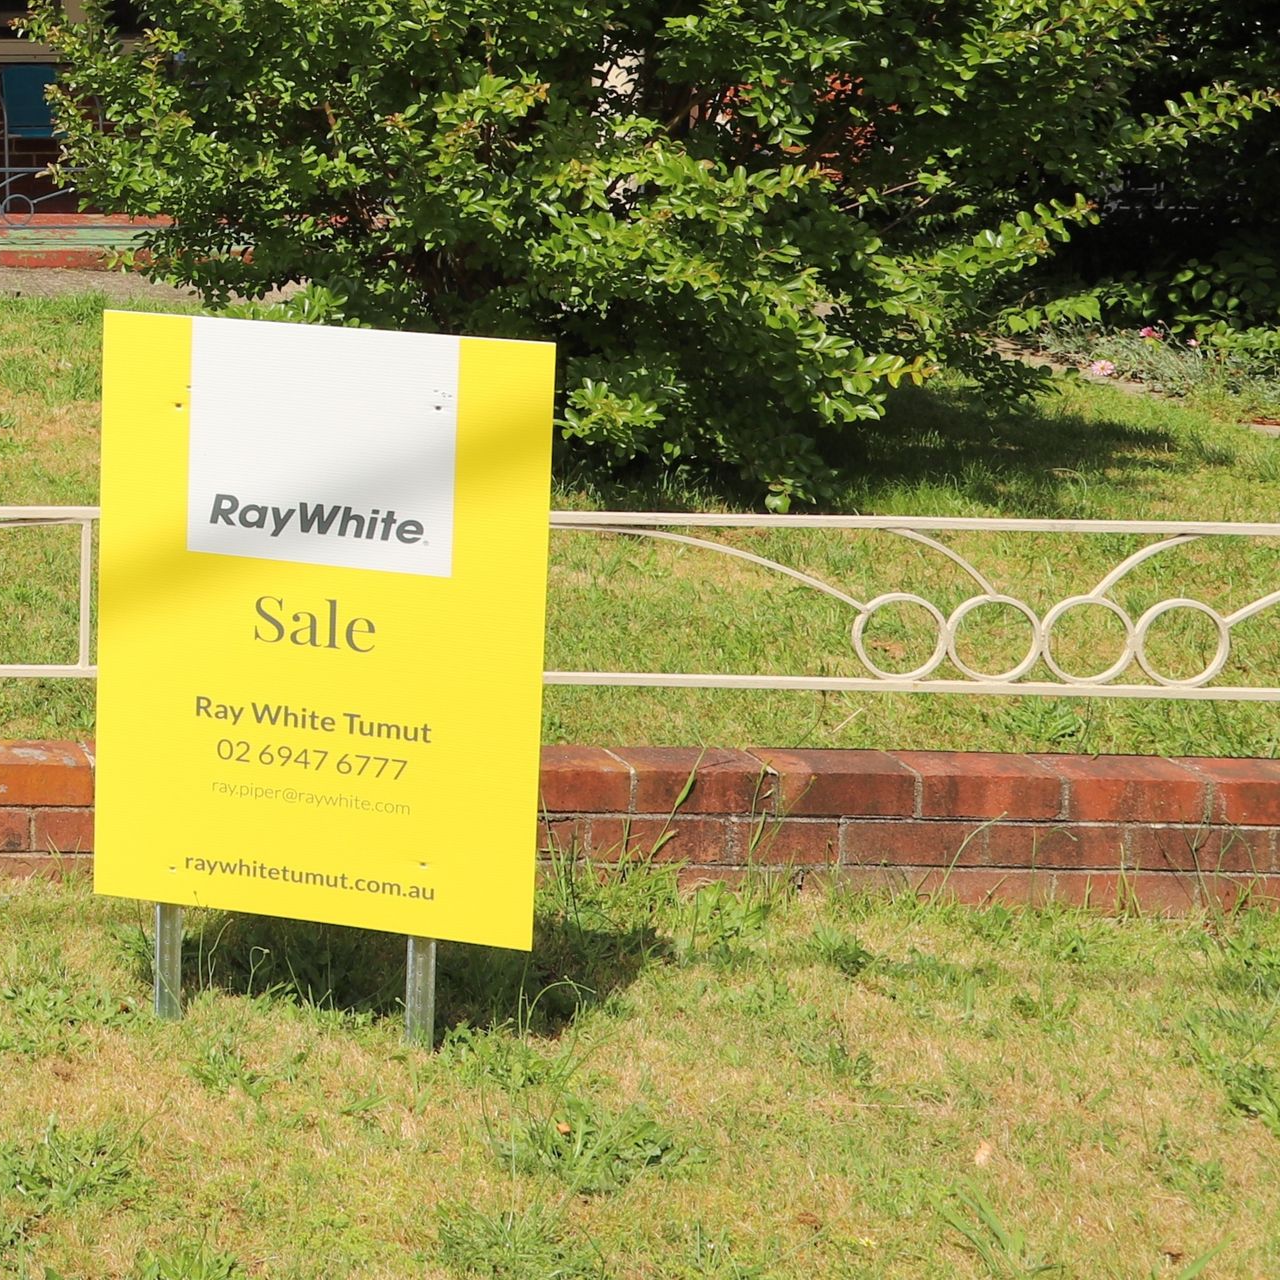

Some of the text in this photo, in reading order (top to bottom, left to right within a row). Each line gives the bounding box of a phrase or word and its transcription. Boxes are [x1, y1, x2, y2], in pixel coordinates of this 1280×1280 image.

[254, 596, 376, 653] Sale
[195, 695, 432, 744] Ray White Tumut
[216, 738, 408, 781] 02 6947 6777
[212, 779, 411, 816] ray.piper@raywhite.com
[185, 856, 435, 901] raywhitetumut.com.au
